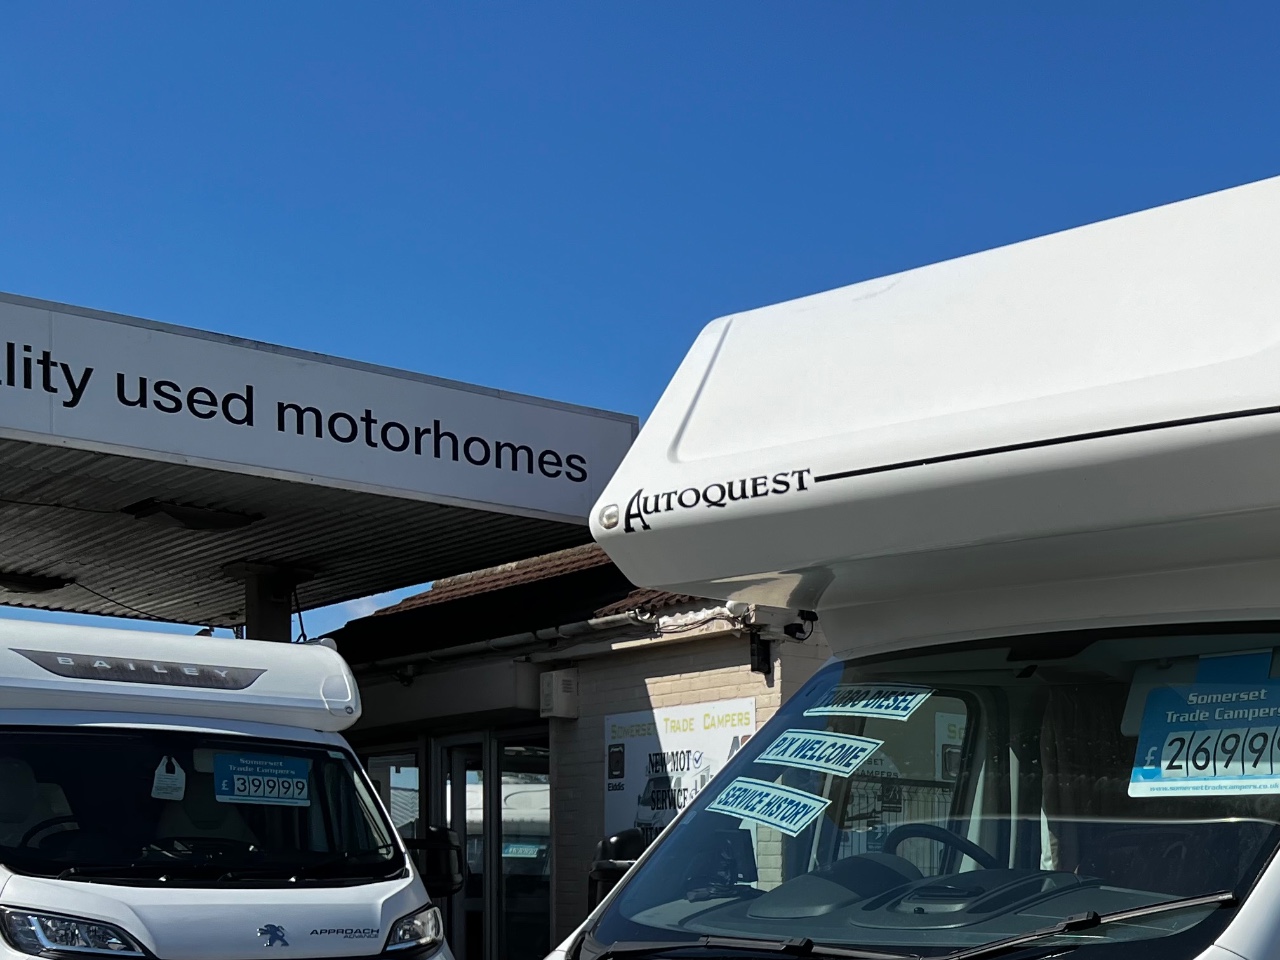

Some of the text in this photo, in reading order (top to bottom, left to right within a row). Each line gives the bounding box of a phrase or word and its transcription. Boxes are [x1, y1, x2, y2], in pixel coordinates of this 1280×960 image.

[0, 342, 589, 484] lity used motorhomes
[57, 656, 229, 677] BAILEY
[862, 690, 920, 712] DIESEL
[1187, 689, 1268, 705] Somerset
[663, 718, 695, 733] TRADE
[703, 712, 751, 730] CAMPERS
[1166, 709, 1209, 723] Trade
[648, 750, 691, 774] NEW MOT
[766, 736, 868, 767] P/X WELCOME
[229, 765, 296, 775] Trade Campers
[240, 758, 284, 767] Somerset
[236, 777, 305, 796] 39999
[717, 786, 816, 826] SERVICE HISTORY
[310, 928, 380, 936] APPROACH
